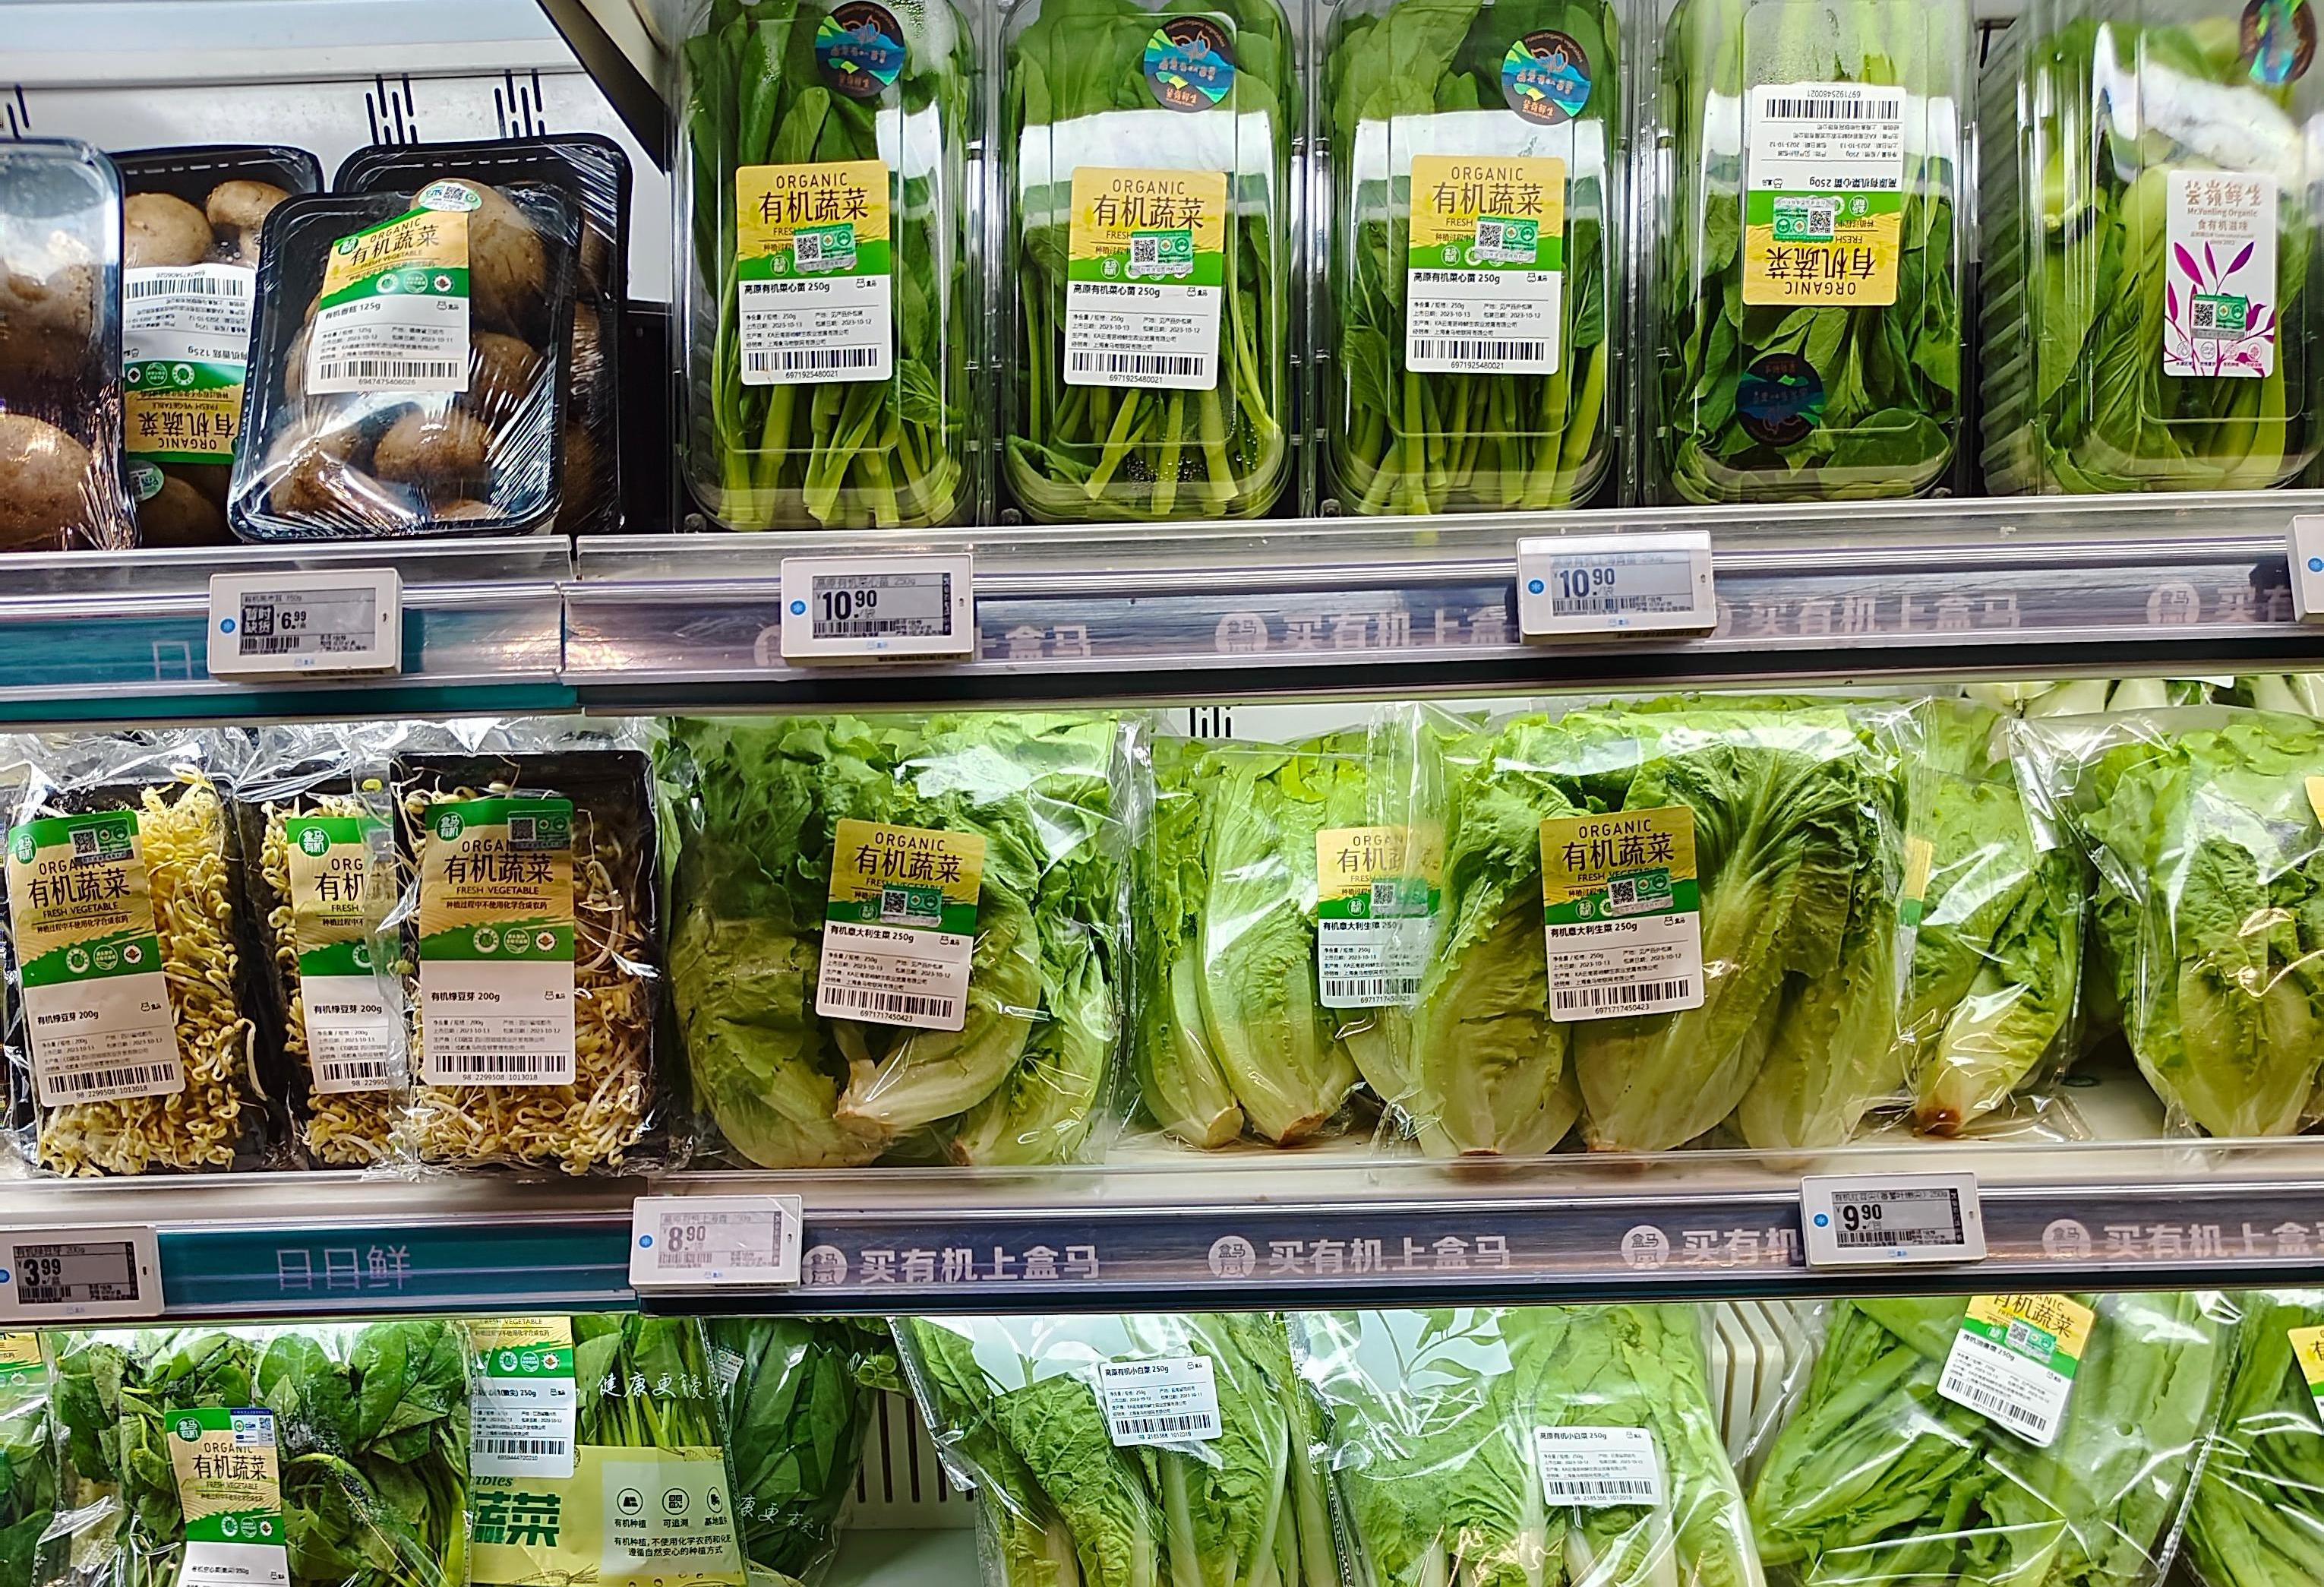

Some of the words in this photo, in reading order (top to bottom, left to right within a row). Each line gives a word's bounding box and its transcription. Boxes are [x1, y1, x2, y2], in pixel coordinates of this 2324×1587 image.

[1807, 90, 1861, 98] 6971925480021
[776, 172, 848, 189] ORGANIC
[1451, 166, 1524, 181] ORGANIC
[1113, 179, 1186, 194] ORGANIC
[1809, 176, 1831, 188] 250g
[758, 188, 869, 224] 有机蔬菜
[1432, 182, 1543, 216] 有机蔬菜
[1093, 194, 1205, 229] 有机蔬菜
[1445, 217, 1473, 226] FRESH
[370, 218, 421, 243] ORGANIC
[773, 227, 794, 236] FRES
[351, 224, 440, 267] 有机蔬菜
[1835, 236, 1863, 244] FRESH
[1765, 246, 1877, 280] 有机蔬菜
[1478, 273, 1501, 285] 250g
[808, 282, 830, 293] 250g
[1138, 287, 1160, 298] 250g
[1785, 281, 1856, 296] ORGANIC
[359, 303, 381, 313] 125g
[188, 346, 211, 357] 125g
[1451, 361, 1504, 370] 6971925480021
[785, 370, 838, 378] 6971925480021
[1109, 375, 1163, 384] 6971925480021
[138, 411, 236, 438] 有机蔬菜
[157, 436, 218, 450] ORGANIC
[1578, 819, 1652, 839] ORGANIC
[462, 839, 511, 853] ORGA
[875, 832, 946, 852] ORGANIC
[1353, 835, 1404, 846] ORGAN
[1561, 832, 1675, 872] 有机蔬菜
[443, 852, 554, 884] 有机蔬菜
[854, 844, 963, 884] 有机蔬菜
[1577, 872, 1605, 882] FRESH
[27, 867, 131, 909] 有机蔬菜
[488, 887, 540, 895] VEGETABLE
[43, 907, 68, 918] FRESH
[70, 902, 119, 914] VEGETABLE
[331, 904, 359, 912] FRESH
[1615, 922, 1637, 932] 250g
[892, 932, 914, 944] 250g
[478, 992, 500, 1003] 200g
[79, 1010, 99, 1020] 200g
[360, 1005, 383, 1014] 200g
[1595, 1003, 1650, 1014] 6971717450423
[860, 1010, 913, 1023] 6971717450423
[76, 1091, 85, 1099] 98
[119, 1085, 149, 1095] 1013018
[1631, 1233, 1659, 1248] 盒马
[2104, 1222, 2324, 1259] 买有机上盒
[1218, 1243, 1246, 1258] 盒马
[1268, 1235, 1511, 1275] 买有机上盒马
[811, 1252, 838, 1266] 盒马
[860, 1244, 1100, 1285] 买有机上盒马
[276, 1244, 411, 1290] 日日鲜
[1152, 1365, 1170, 1374] 250g
[1589, 1432, 1608, 1440] 250g
[191, 1454, 267, 1481] 有机蔬菜
